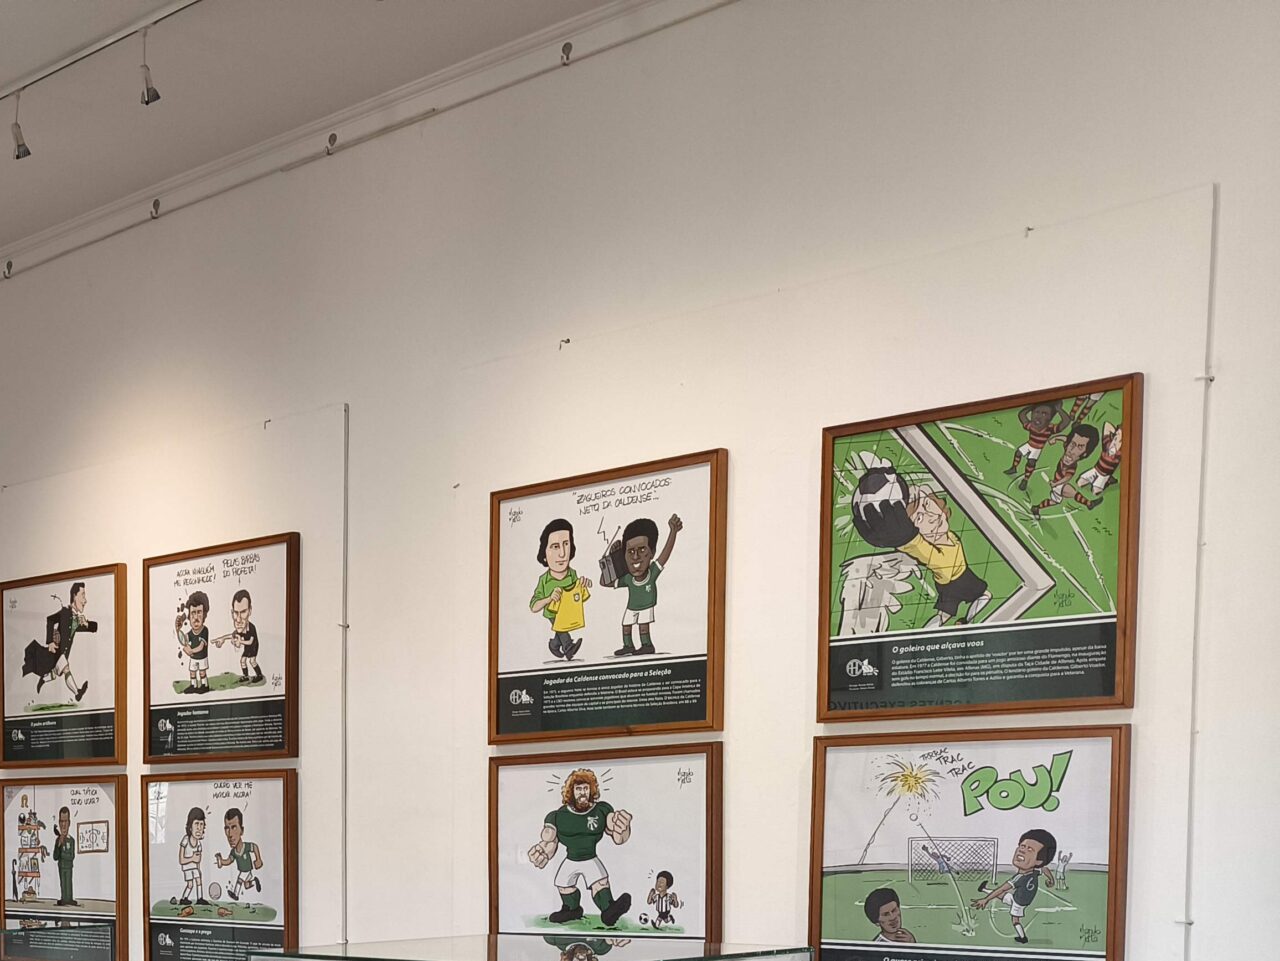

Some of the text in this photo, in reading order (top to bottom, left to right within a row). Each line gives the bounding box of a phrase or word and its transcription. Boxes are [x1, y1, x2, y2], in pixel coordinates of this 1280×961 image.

[579, 503, 599, 516] NETO
[602, 500, 612, 510] DA
[892, 646, 899, 654] O
[899, 644, 925, 655] goleiro
[926, 643, 940, 652] que
[940, 641, 966, 650] alçava
[574, 674, 598, 682] Caldense
[599, 672, 629, 680] convocado
[629, 671, 643, 679] para
[649, 668, 671, 676] Seleção
[935, 752, 964, 765] TRAC
[947, 761, 976, 778] TRAC
[961, 749, 1073, 817] POU!
[1026, 876, 1035, 891] 6
